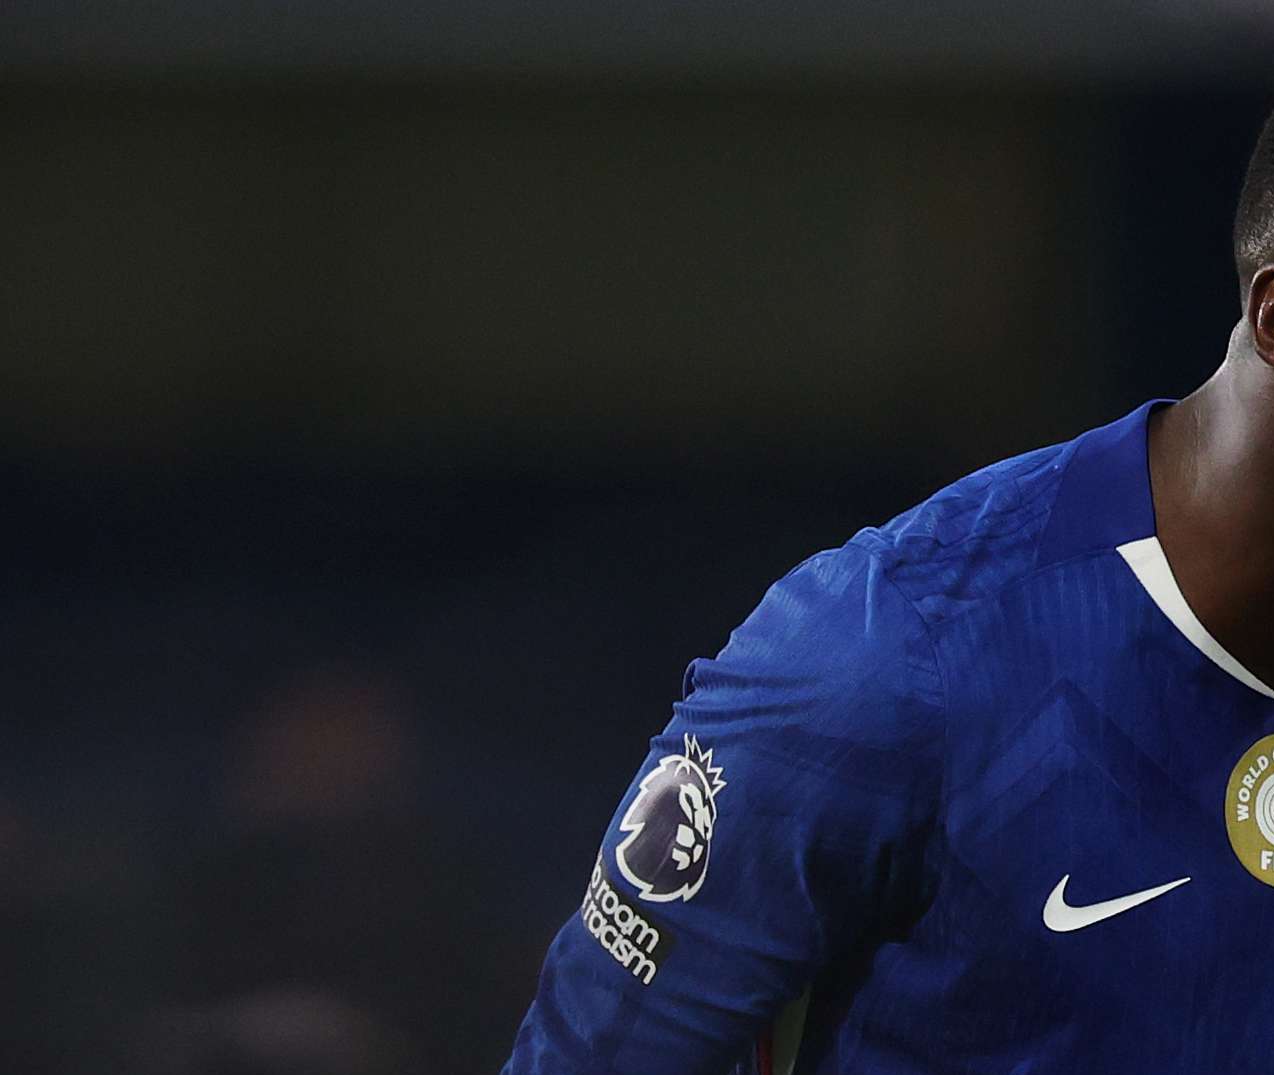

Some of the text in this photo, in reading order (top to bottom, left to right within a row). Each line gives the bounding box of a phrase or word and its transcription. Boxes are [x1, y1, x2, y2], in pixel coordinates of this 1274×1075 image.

[1237, 755, 1269, 822] WORLD
[584, 901, 656, 985] racism
[595, 880, 659, 953] room
